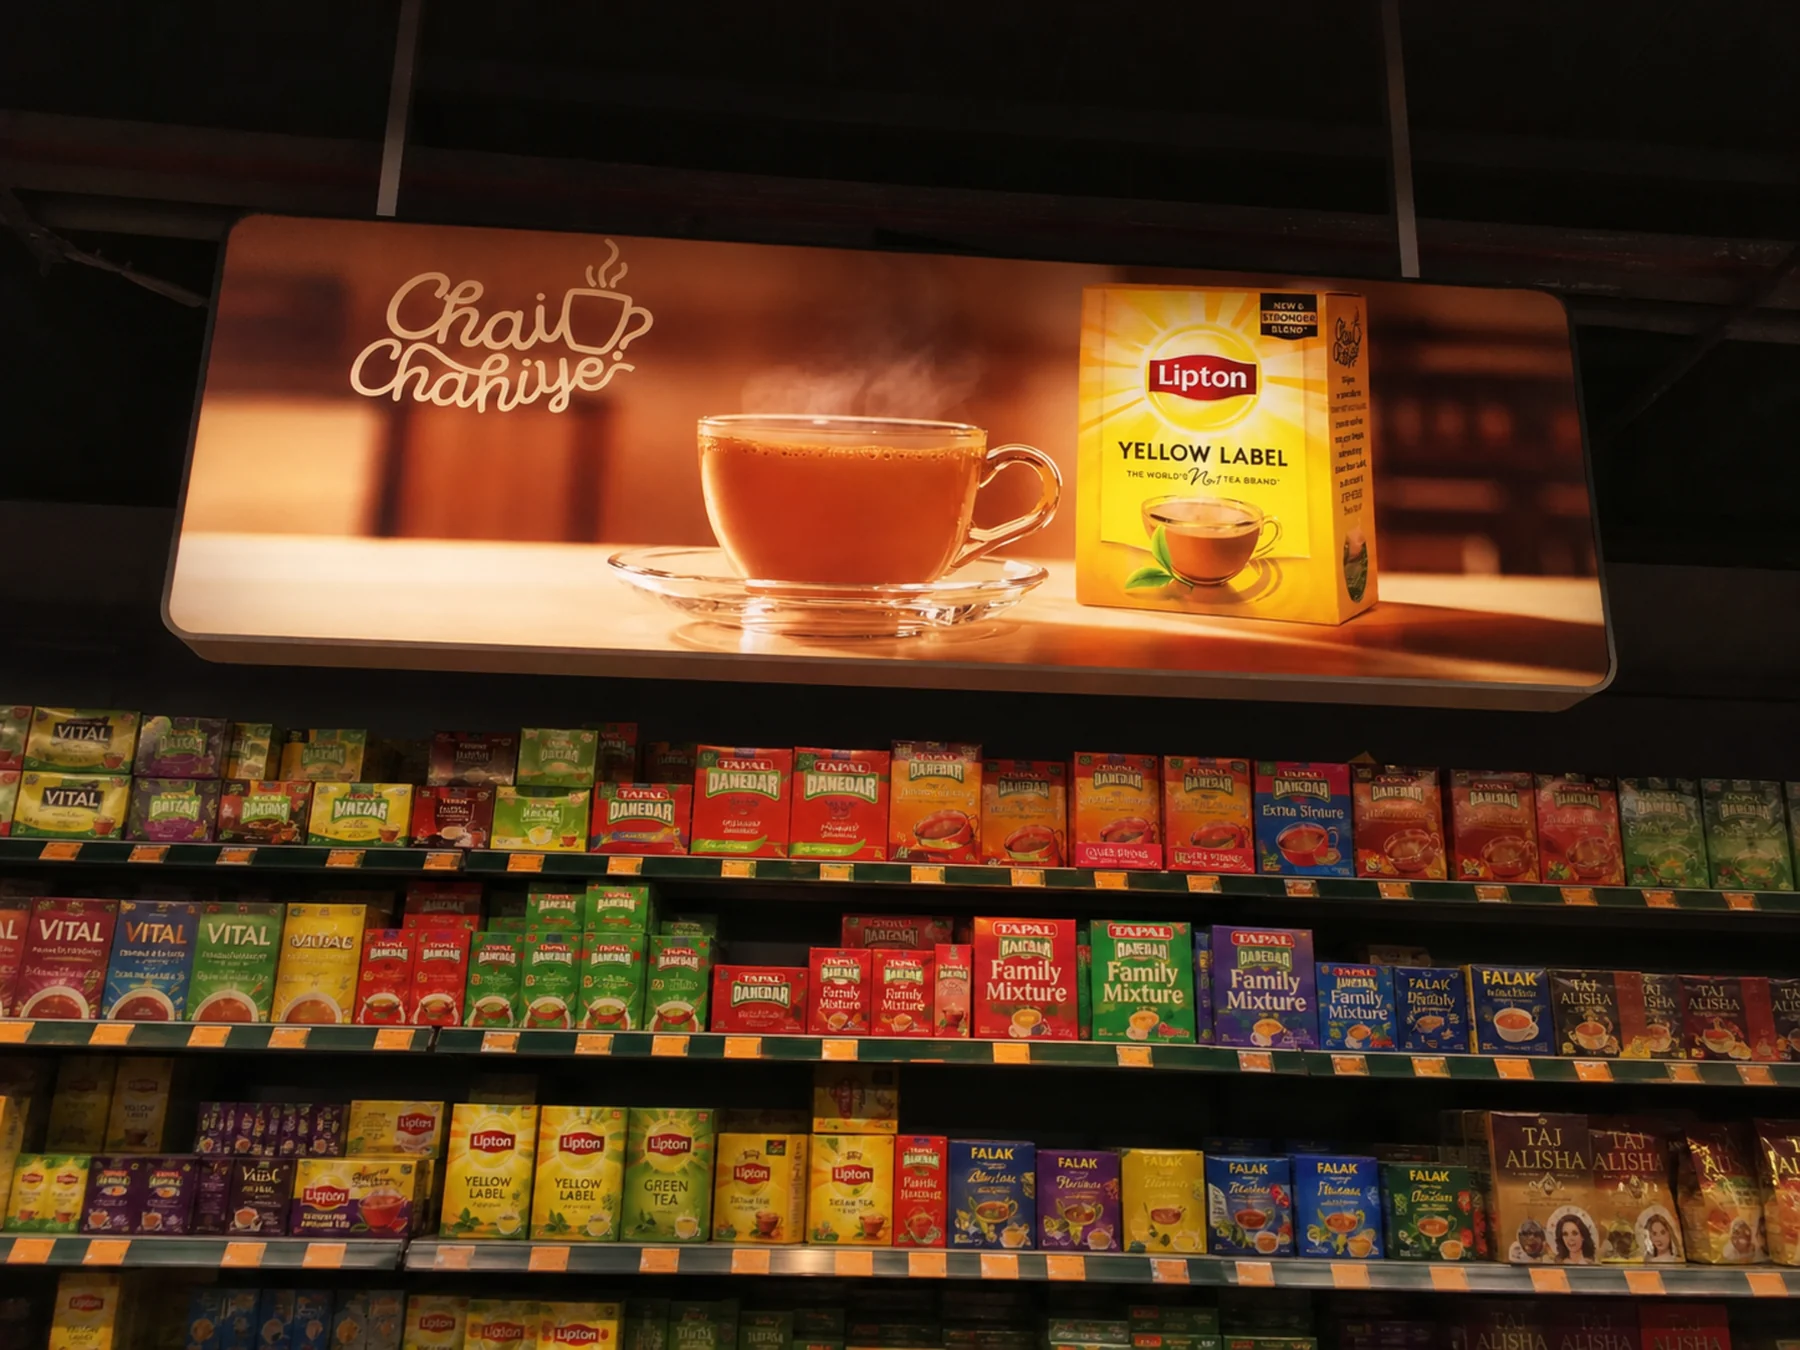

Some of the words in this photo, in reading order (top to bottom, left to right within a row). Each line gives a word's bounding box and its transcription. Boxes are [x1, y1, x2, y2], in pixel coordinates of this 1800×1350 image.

[1273, 302, 1296, 310] NEW
[1158, 364, 1248, 391] Lipton
[1118, 441, 1211, 463] YELLOW
[1220, 446, 1288, 467] LABEL
[1127, 470, 1145, 478] THE
[1224, 476, 1241, 485] TEA
[57, 725, 109, 743] VITAL
[708, 771, 779, 796] DANEDAR
[806, 774, 877, 800] DANEDAR
[45, 790, 99, 807] VITAL
[609, 801, 673, 821] DANEDAR
[40, 919, 104, 943] VITAL
[126, 921, 187, 944] VITAL
[208, 923, 271, 946] VITAL
[997, 924, 1055, 936] TAPAL
[1112, 926, 1171, 938] TAPAL
[1235, 933, 1293, 946] TAPAL
[991, 960, 1062, 985] Family
[1107, 962, 1178, 987] Family
[1483, 970, 1538, 986] FALAK
[1230, 969, 1300, 996] Family
[1409, 977, 1451, 990] FALAK
[986, 982, 1067, 1003] Mixture
[1103, 984, 1184, 1004] Mixture
[1700, 985, 1724, 997] TAJ
[1227, 991, 1307, 1012] Mixture
[1331, 990, 1384, 1009] Family
[1560, 992, 1612, 1006] ALISHA
[1688, 997, 1740, 1011] ALISHA
[1329, 1004, 1388, 1020] Mixture
[473, 1134, 512, 1149] Lipton
[562, 1136, 601, 1151] Lipton
[1522, 1126, 1562, 1147] TAJ
[1611, 1132, 1645, 1150] TAJ
[650, 1138, 688, 1152] Lipton
[971, 1147, 1014, 1160] FALAK
[1505, 1150, 1587, 1170] ALISHA
[1058, 1157, 1098, 1169] FALAK
[1143, 1156, 1182, 1168] FALAK
[1229, 1162, 1268, 1175] FALAK
[1317, 1162, 1358, 1175] FALAK
[1592, 1153, 1664, 1172] ALISHA
[464, 1176, 512, 1188] YELLOW
[735, 1168, 768, 1181] Lipton
[834, 1169, 871, 1182] Lipton
[1409, 1170, 1449, 1182] FALAK
[554, 1178, 602, 1190] YELLOW
[644, 1179, 689, 1193] GREEN
[469, 1188, 505, 1200] LABEL
[559, 1190, 596, 1201] LABEL
[652, 1193, 678, 1206] TEA
[421, 1316, 454, 1330] Lipton
[556, 1328, 597, 1341] Lipton
[1476, 1333, 1548, 1350] ALISHA
[1561, 1334, 1632, 1350] ALISHA
[1654, 1335, 1721, 1350] ALISHA
